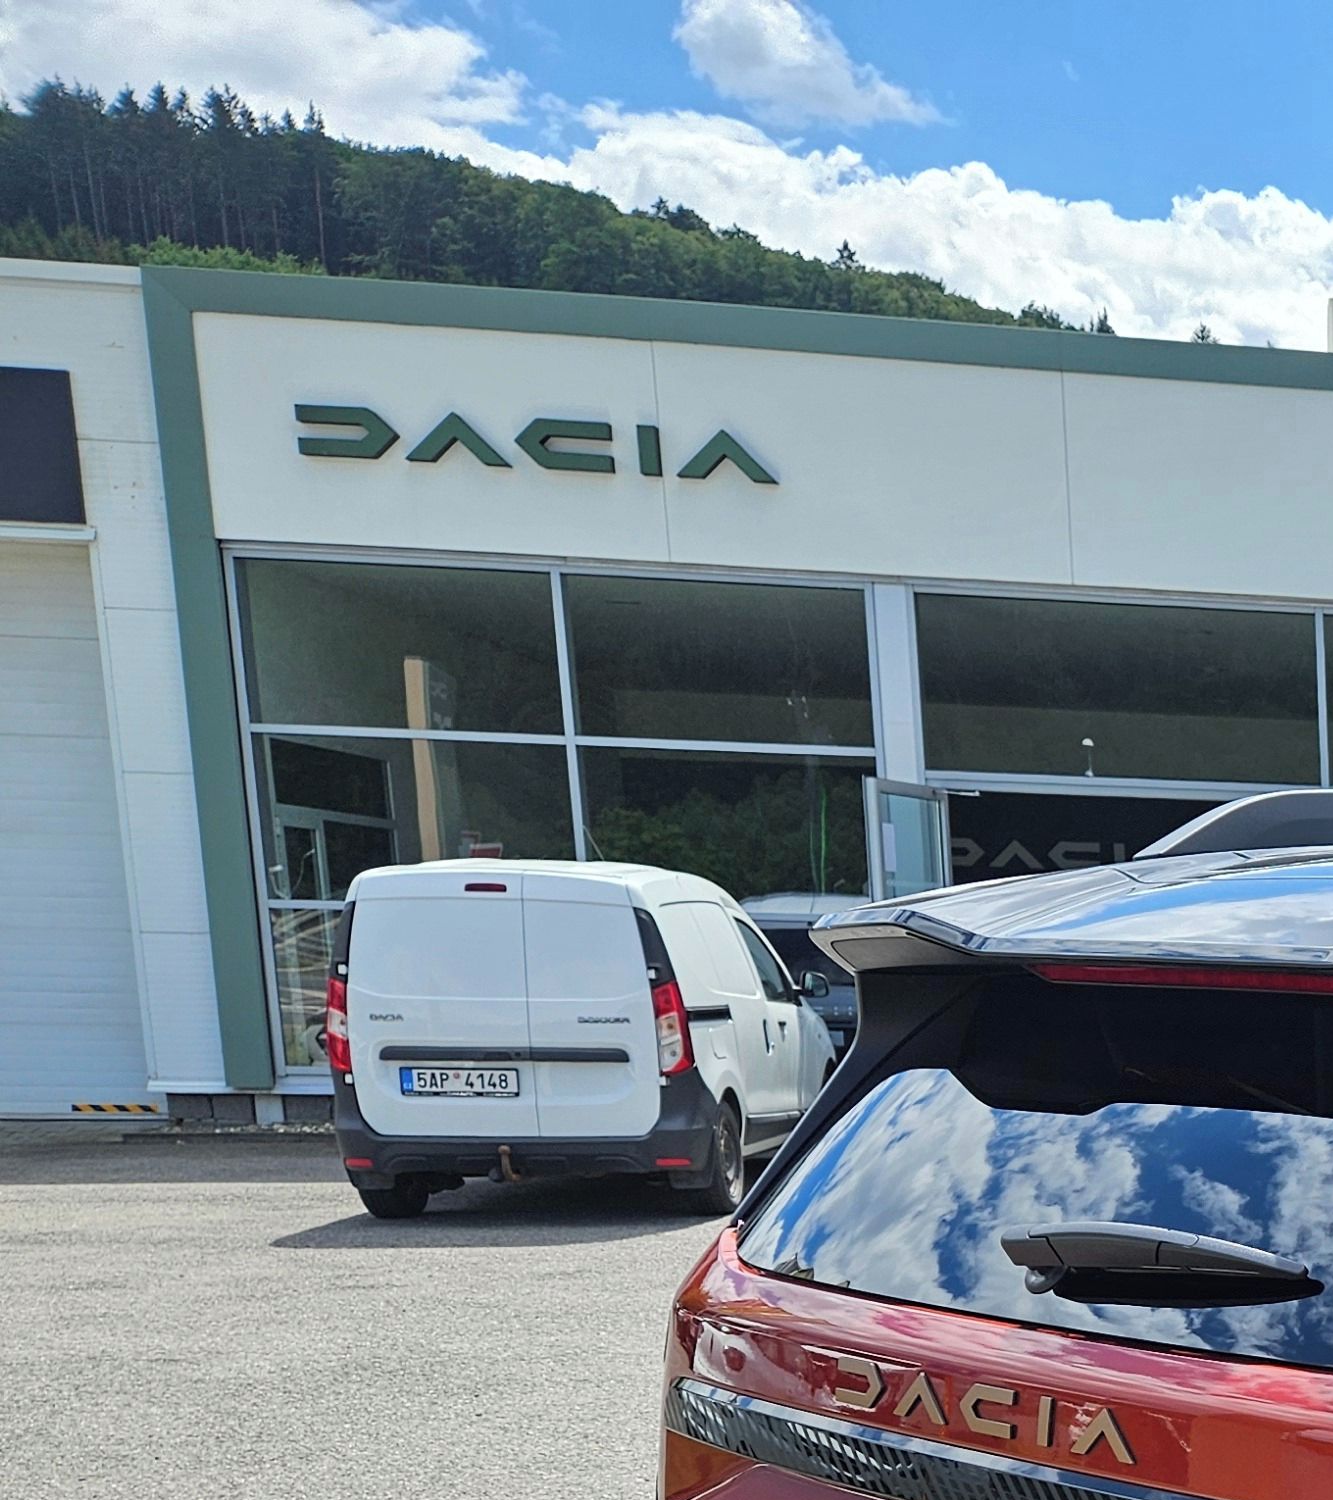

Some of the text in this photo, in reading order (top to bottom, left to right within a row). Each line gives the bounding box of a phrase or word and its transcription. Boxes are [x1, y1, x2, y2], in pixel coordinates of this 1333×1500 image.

[294, 404, 778, 485] DACIA
[951, 837, 1126, 869] DACI
[416, 1071, 510, 1090] 5AP 4148
[834, 1356, 1137, 1465] DACIA
